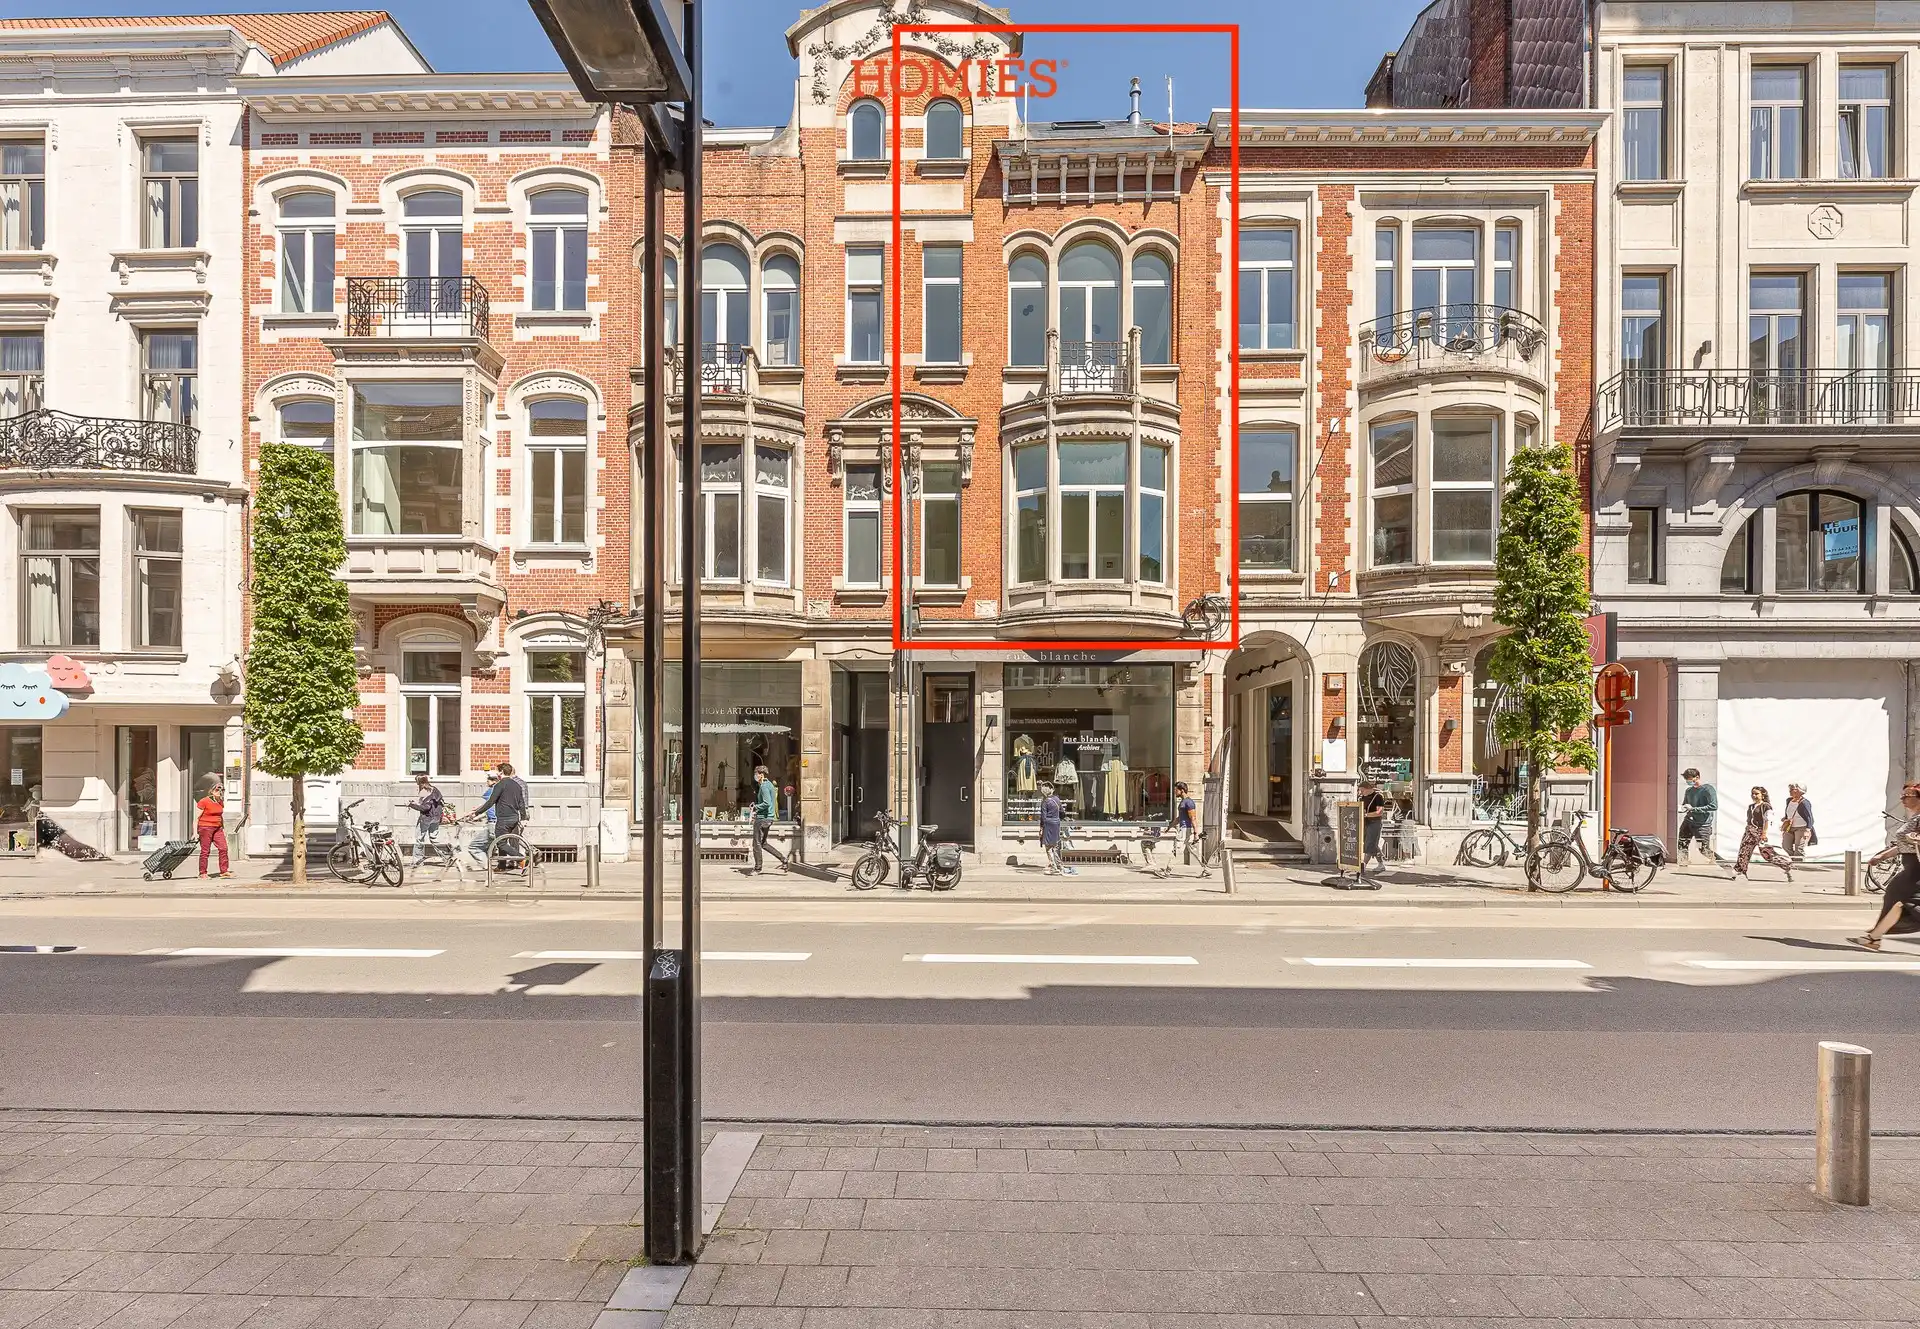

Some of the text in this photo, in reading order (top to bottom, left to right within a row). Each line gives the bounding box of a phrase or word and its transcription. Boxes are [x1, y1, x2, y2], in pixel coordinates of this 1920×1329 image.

[1823, 520, 1840, 529] TE
[1823, 524, 1859, 535] HUUR
[1006, 651, 1097, 661] rue blanche
[726, 707, 743, 715] ART
[745, 707, 780, 715] GALLERY
[1080, 734, 1114, 743] blanche
